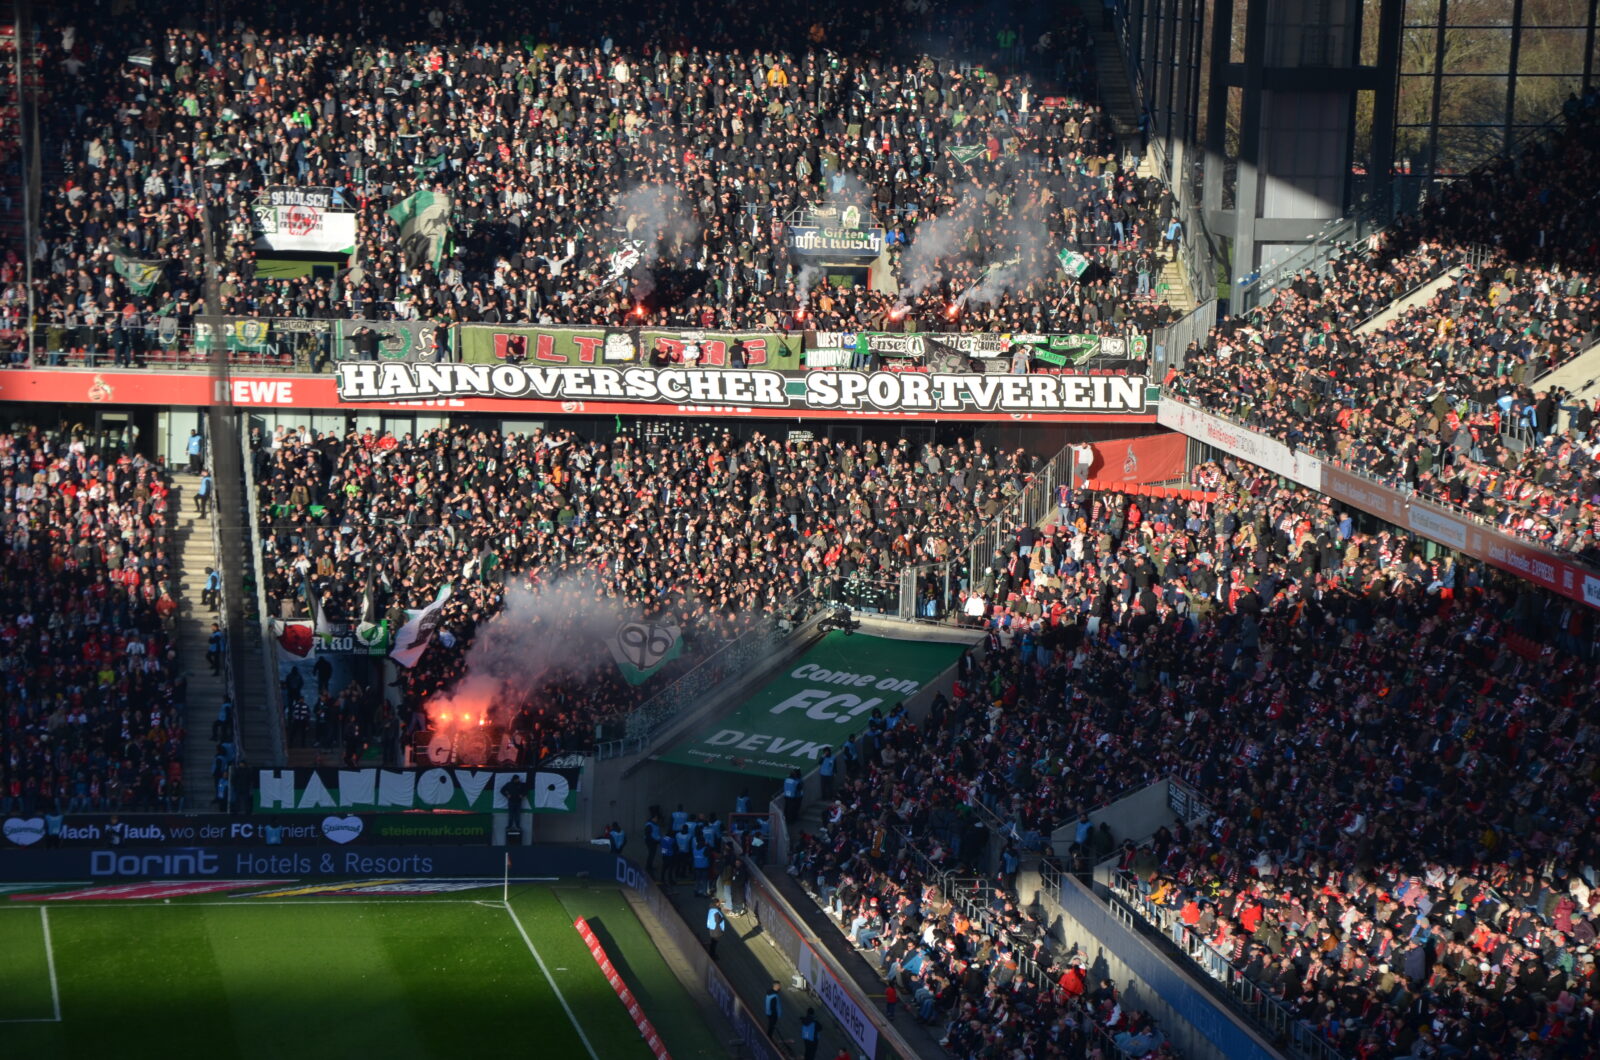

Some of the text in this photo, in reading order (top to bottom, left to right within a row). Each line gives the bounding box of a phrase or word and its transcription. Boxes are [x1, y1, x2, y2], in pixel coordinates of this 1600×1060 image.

[271, 191, 284, 205] 96
[341, 363, 1145, 408] HANNOVERSCHER SPORTVEREIN
[790, 663, 877, 688] Come
[769, 688, 885, 724] FC!
[704, 729, 834, 760] DEVK
[170, 828, 194, 839] wo
[200, 824, 226, 839] der
[231, 823, 253, 838] FC
[381, 825, 484, 837] steiermark.com
[91, 850, 433, 875] Dorint Hotels & Resorts
[820, 967, 833, 1000] Das
[850, 1005, 865, 1043] Herz
